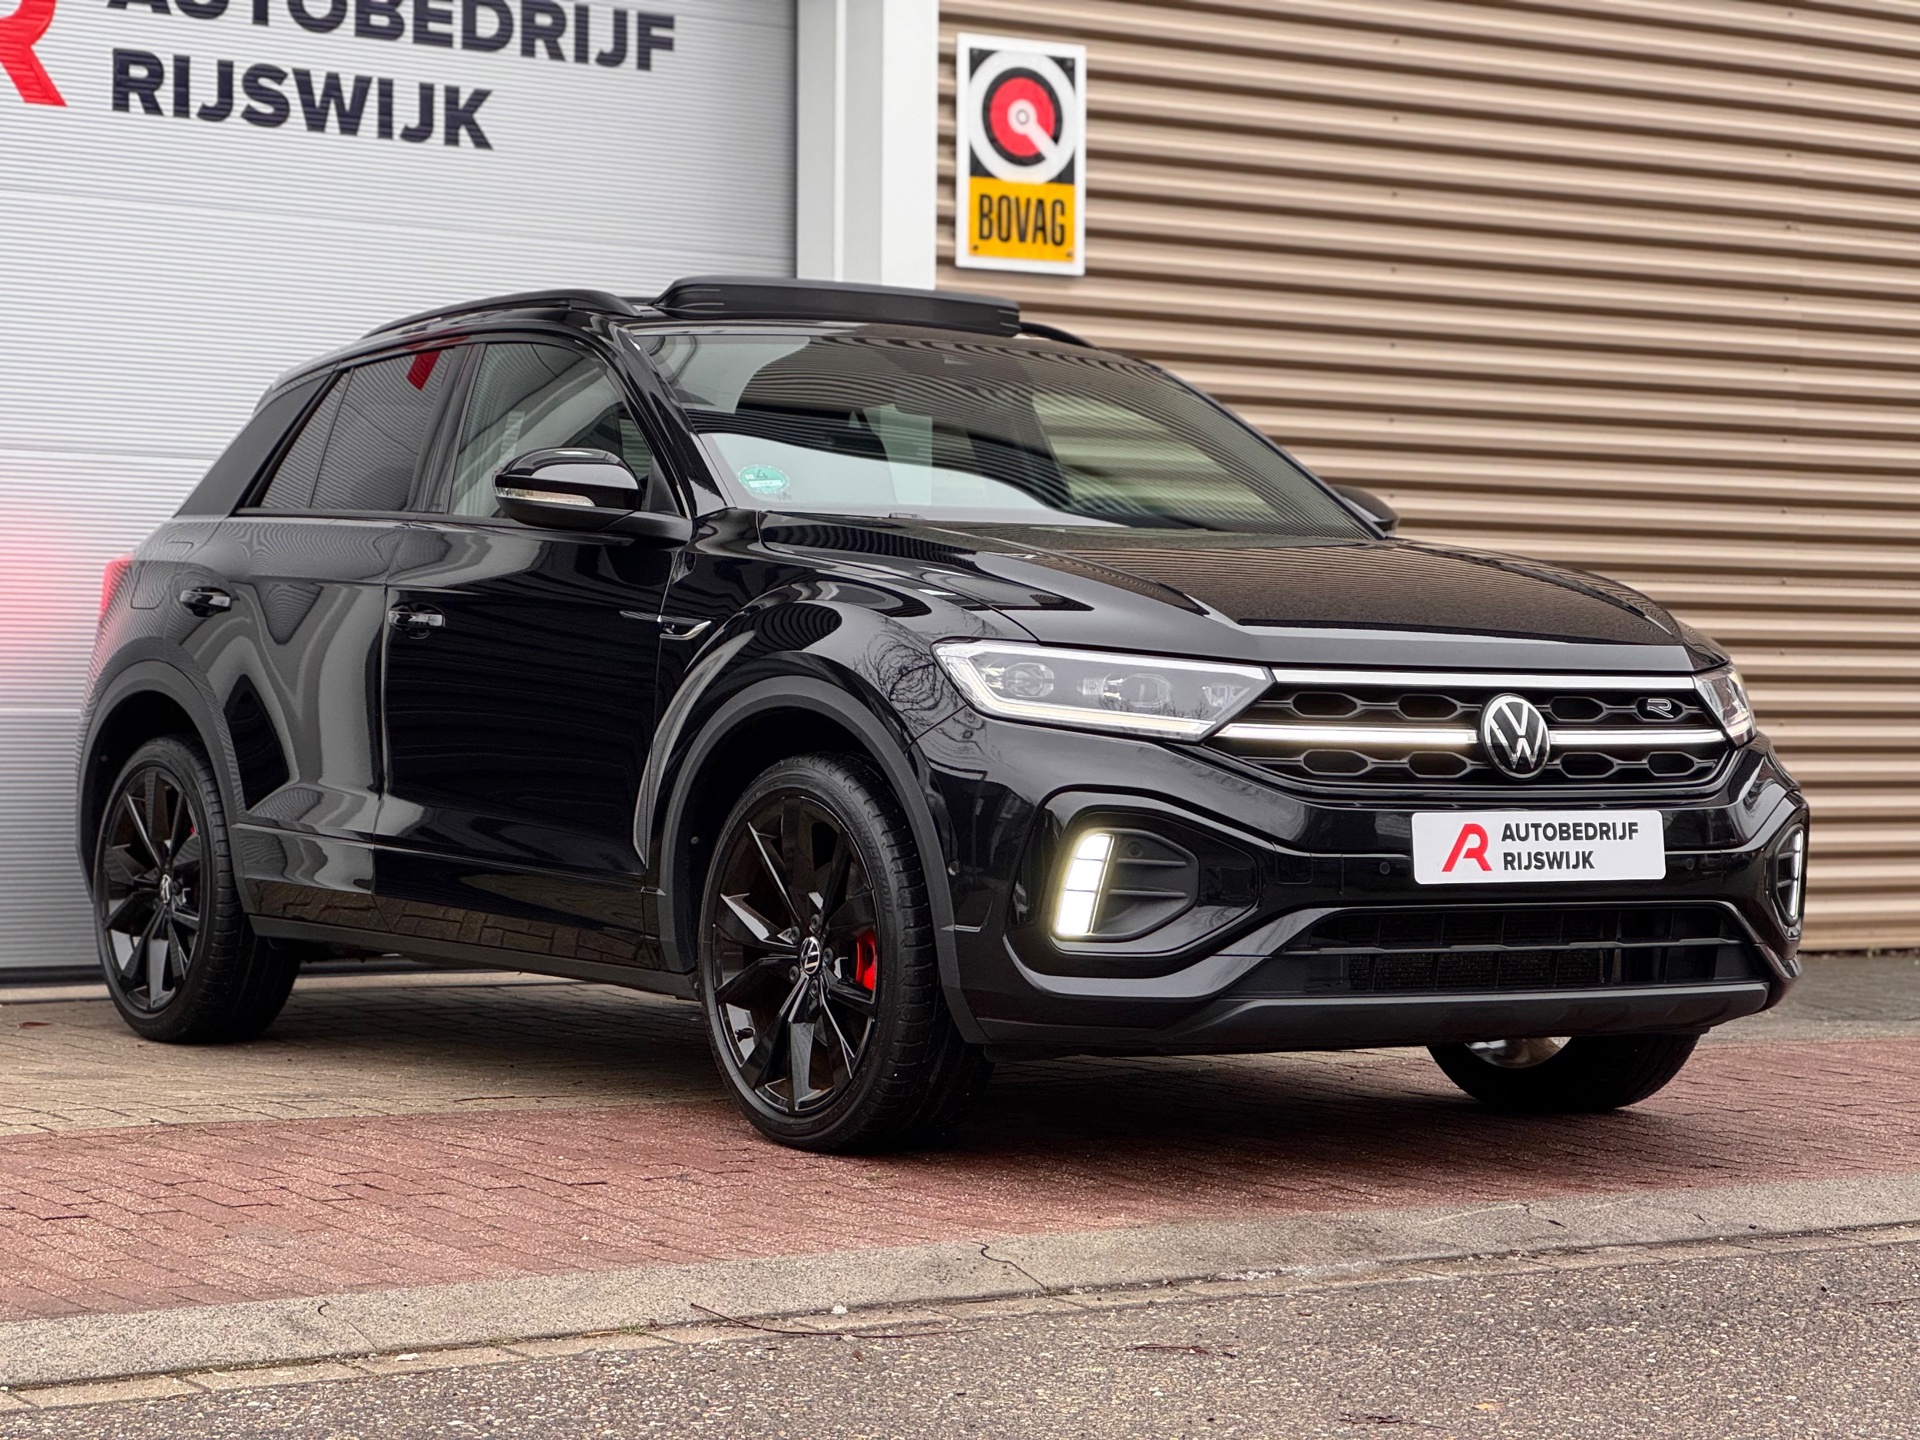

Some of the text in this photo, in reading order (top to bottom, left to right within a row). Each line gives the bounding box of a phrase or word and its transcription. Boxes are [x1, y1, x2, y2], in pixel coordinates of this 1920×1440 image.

[106, 0, 675, 72] OBEDRIJF
[112, 48, 494, 151] RIJSWIJK
[978, 193, 1066, 248] BOVAG
[1501, 821, 1639, 842] AUTOBEDRIJF
[1503, 850, 1595, 871] RIJSWIJK
